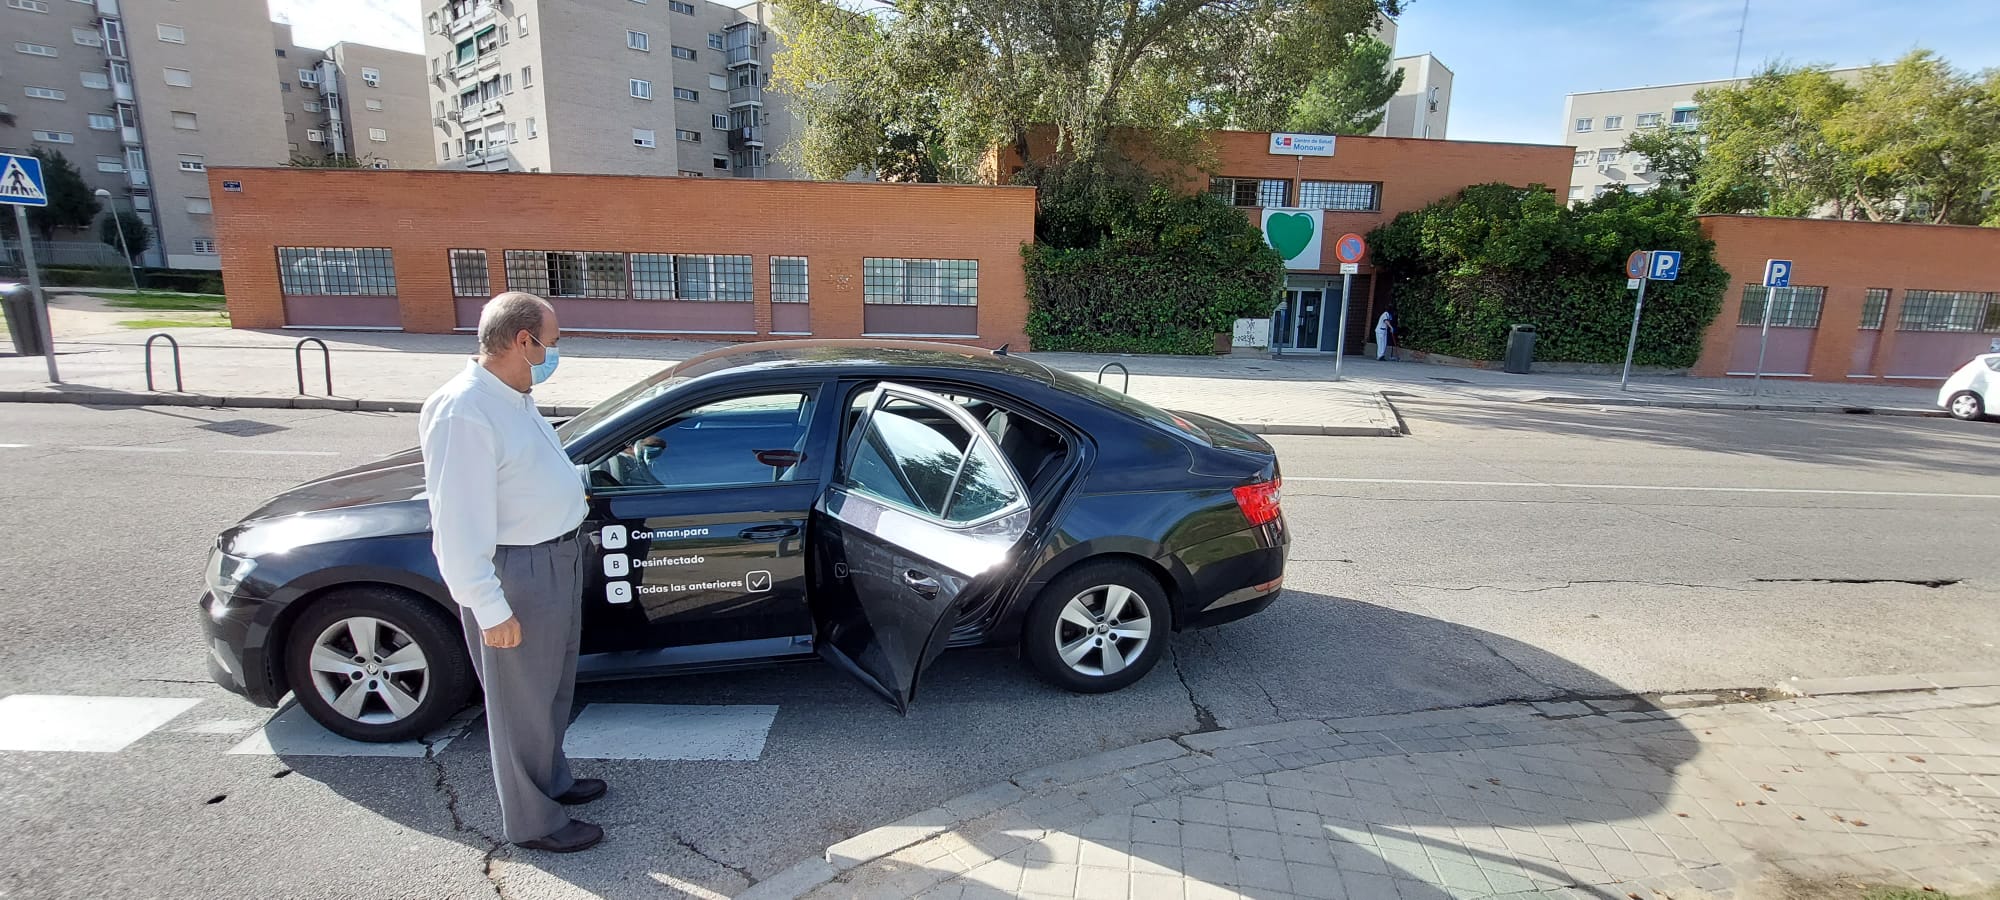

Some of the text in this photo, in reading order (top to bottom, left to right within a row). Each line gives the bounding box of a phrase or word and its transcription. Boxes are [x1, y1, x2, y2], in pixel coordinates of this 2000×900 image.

[1293, 143, 1325, 151] Monovar
[1655, 254, 1674, 277] P
[1770, 263, 1787, 285] P
[610, 531, 619, 541] A
[631, 530, 654, 540] Con
[612, 555, 705, 569] B Desinfectado
[614, 579, 743, 596] C Todas las anteriores
